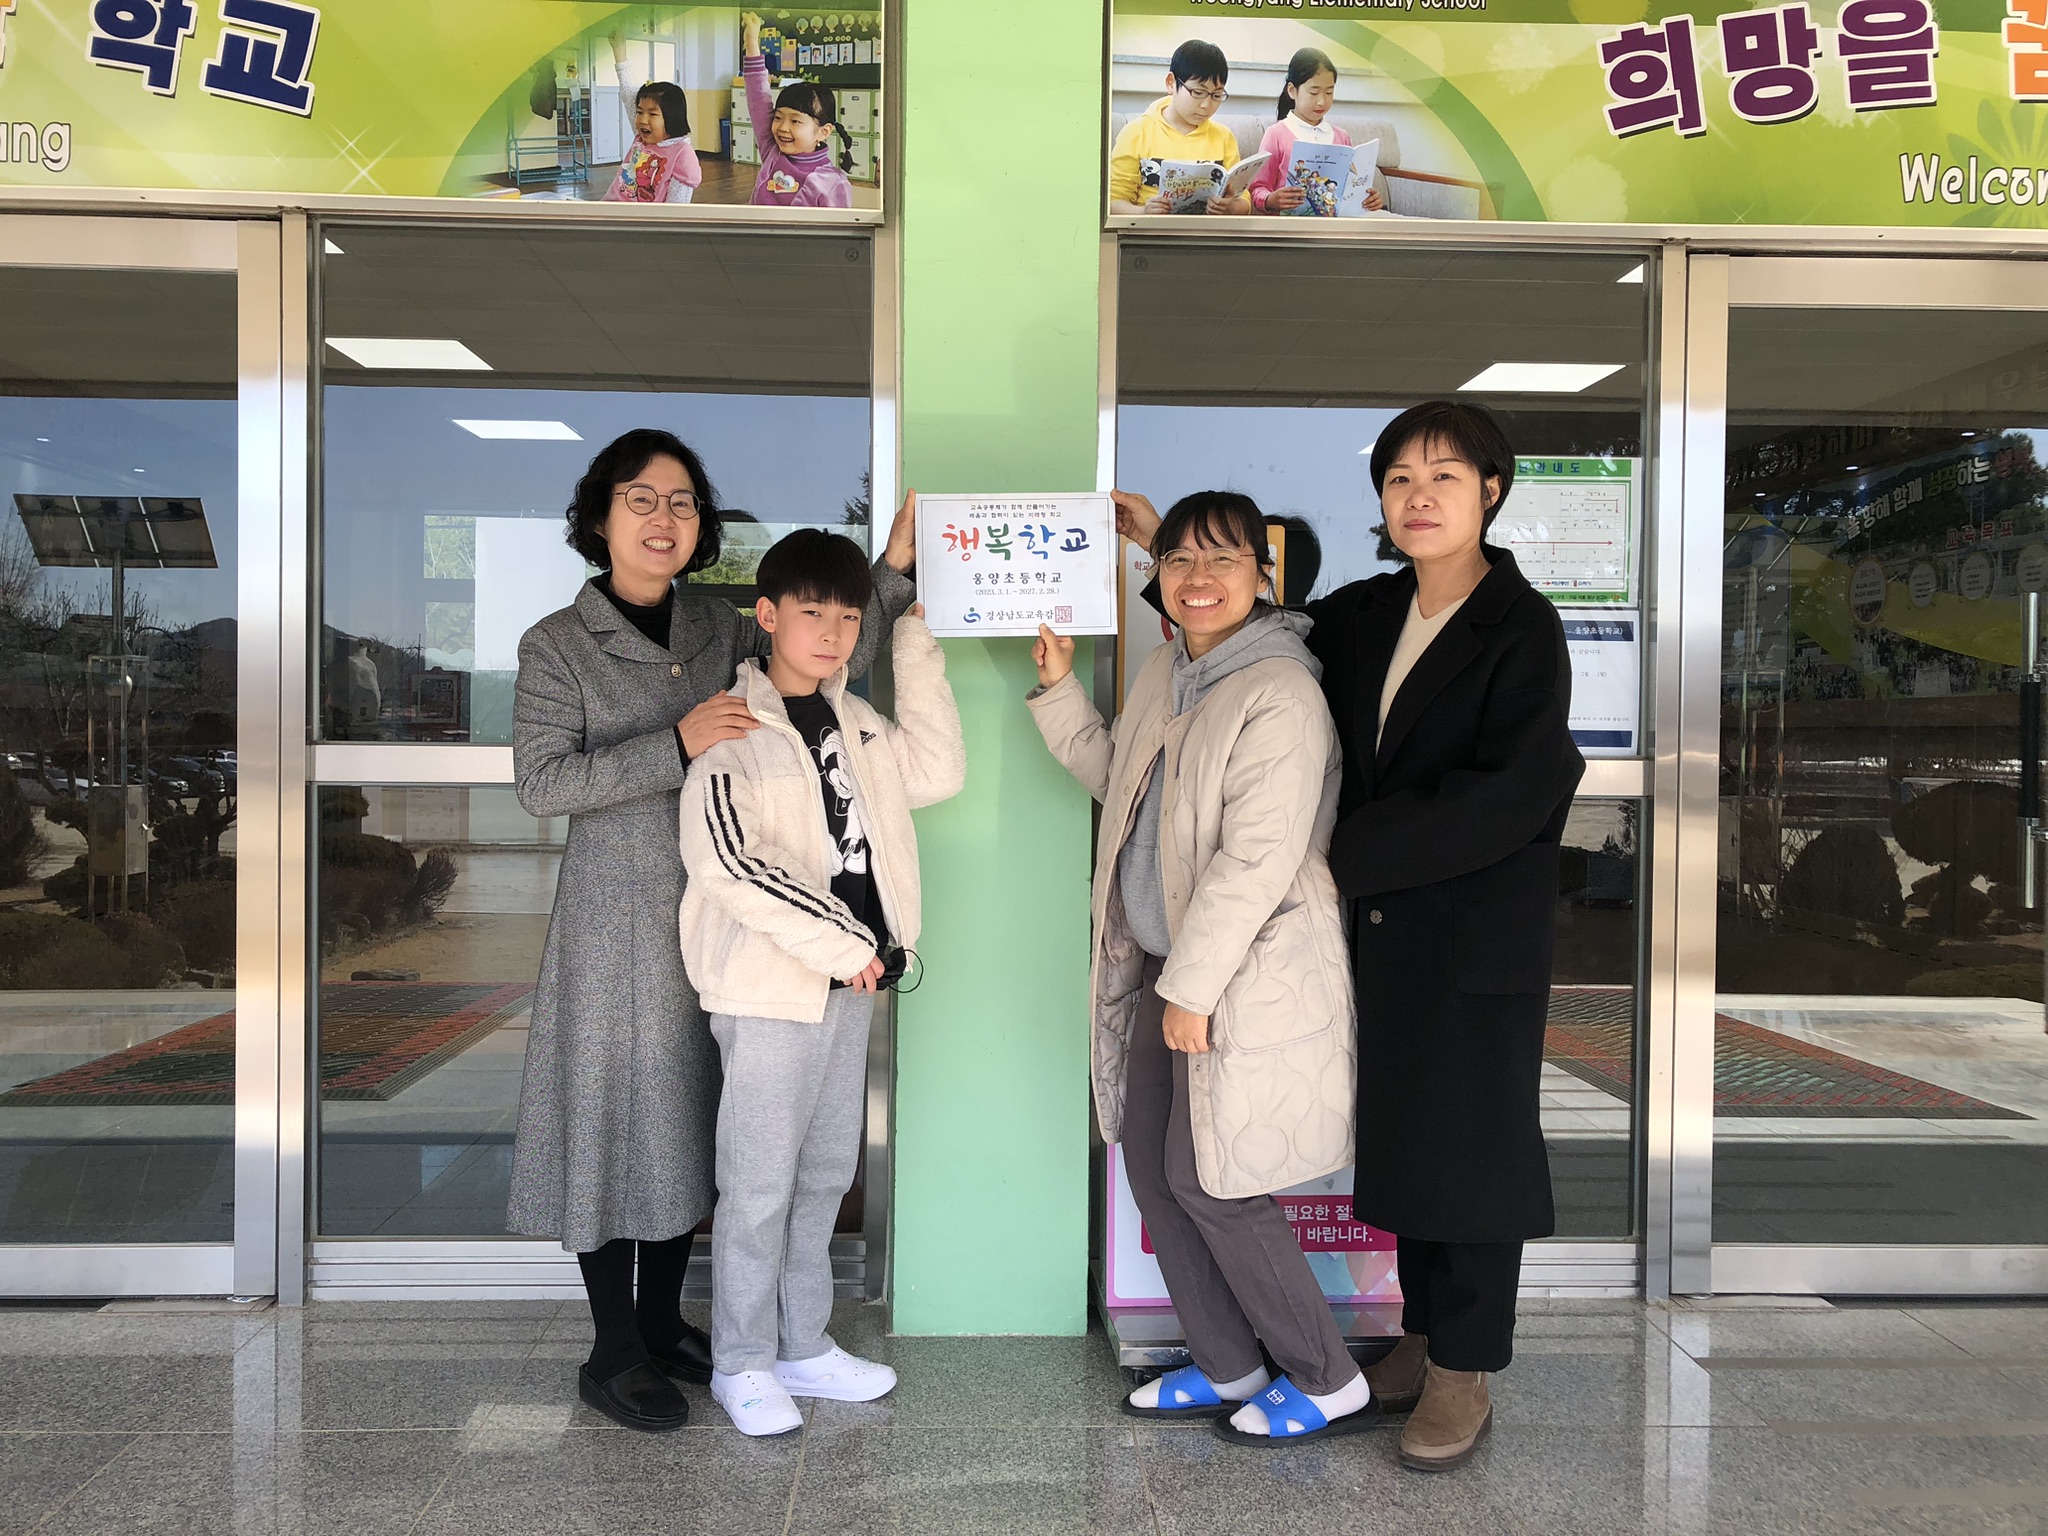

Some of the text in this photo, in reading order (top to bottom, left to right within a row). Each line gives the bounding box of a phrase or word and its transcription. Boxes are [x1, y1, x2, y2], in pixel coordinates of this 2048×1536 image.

[1599, 0, 1937, 138] 희망을
[941, 523, 1090, 561] 행복학교
[972, 572, 1063, 585] 웅양초등학교
[1284, 1204, 1354, 1221] 필요한 절
[1307, 1226, 1373, 1243] 바랍니다.
